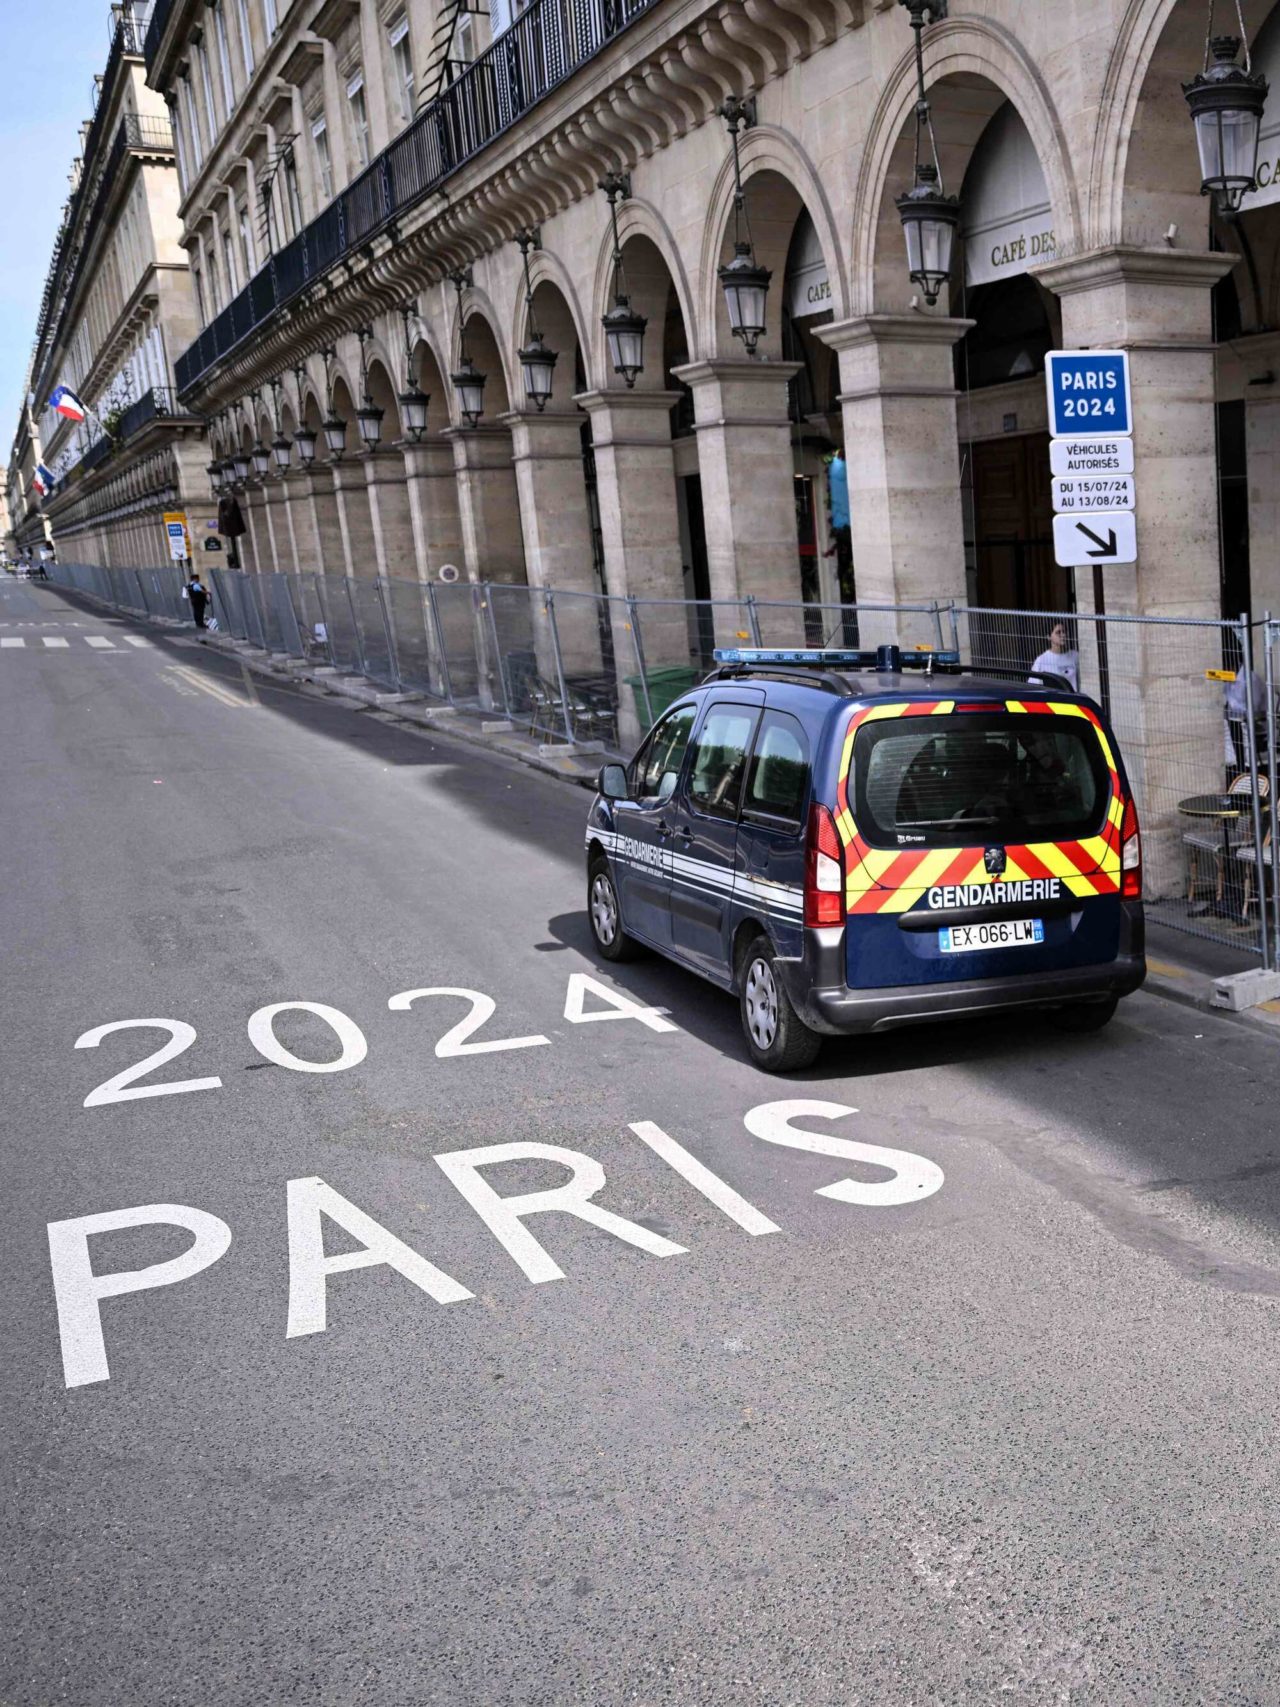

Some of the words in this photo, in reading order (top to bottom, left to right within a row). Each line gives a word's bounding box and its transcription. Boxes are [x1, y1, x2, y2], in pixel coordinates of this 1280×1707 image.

[991, 234, 1026, 267] CAFÉ
[1061, 370, 1117, 391] PARIS
[1064, 397, 1116, 417] 2024
[1066, 444, 1118, 456] VÉHICULES
[1068, 458, 1119, 470] AUTORISÉS
[1060, 483, 1073, 493] DU
[1078, 481, 1128, 492] 15/07/24
[1061, 497, 1074, 507] AU
[1079, 496, 1128, 506] 13/08/24
[928, 877, 1060, 909] GENDARMERIE
[951, 921, 1034, 947] EX-066-LW
[73, 972, 679, 1107] 2024
[47, 1099, 945, 1388] PARIS
